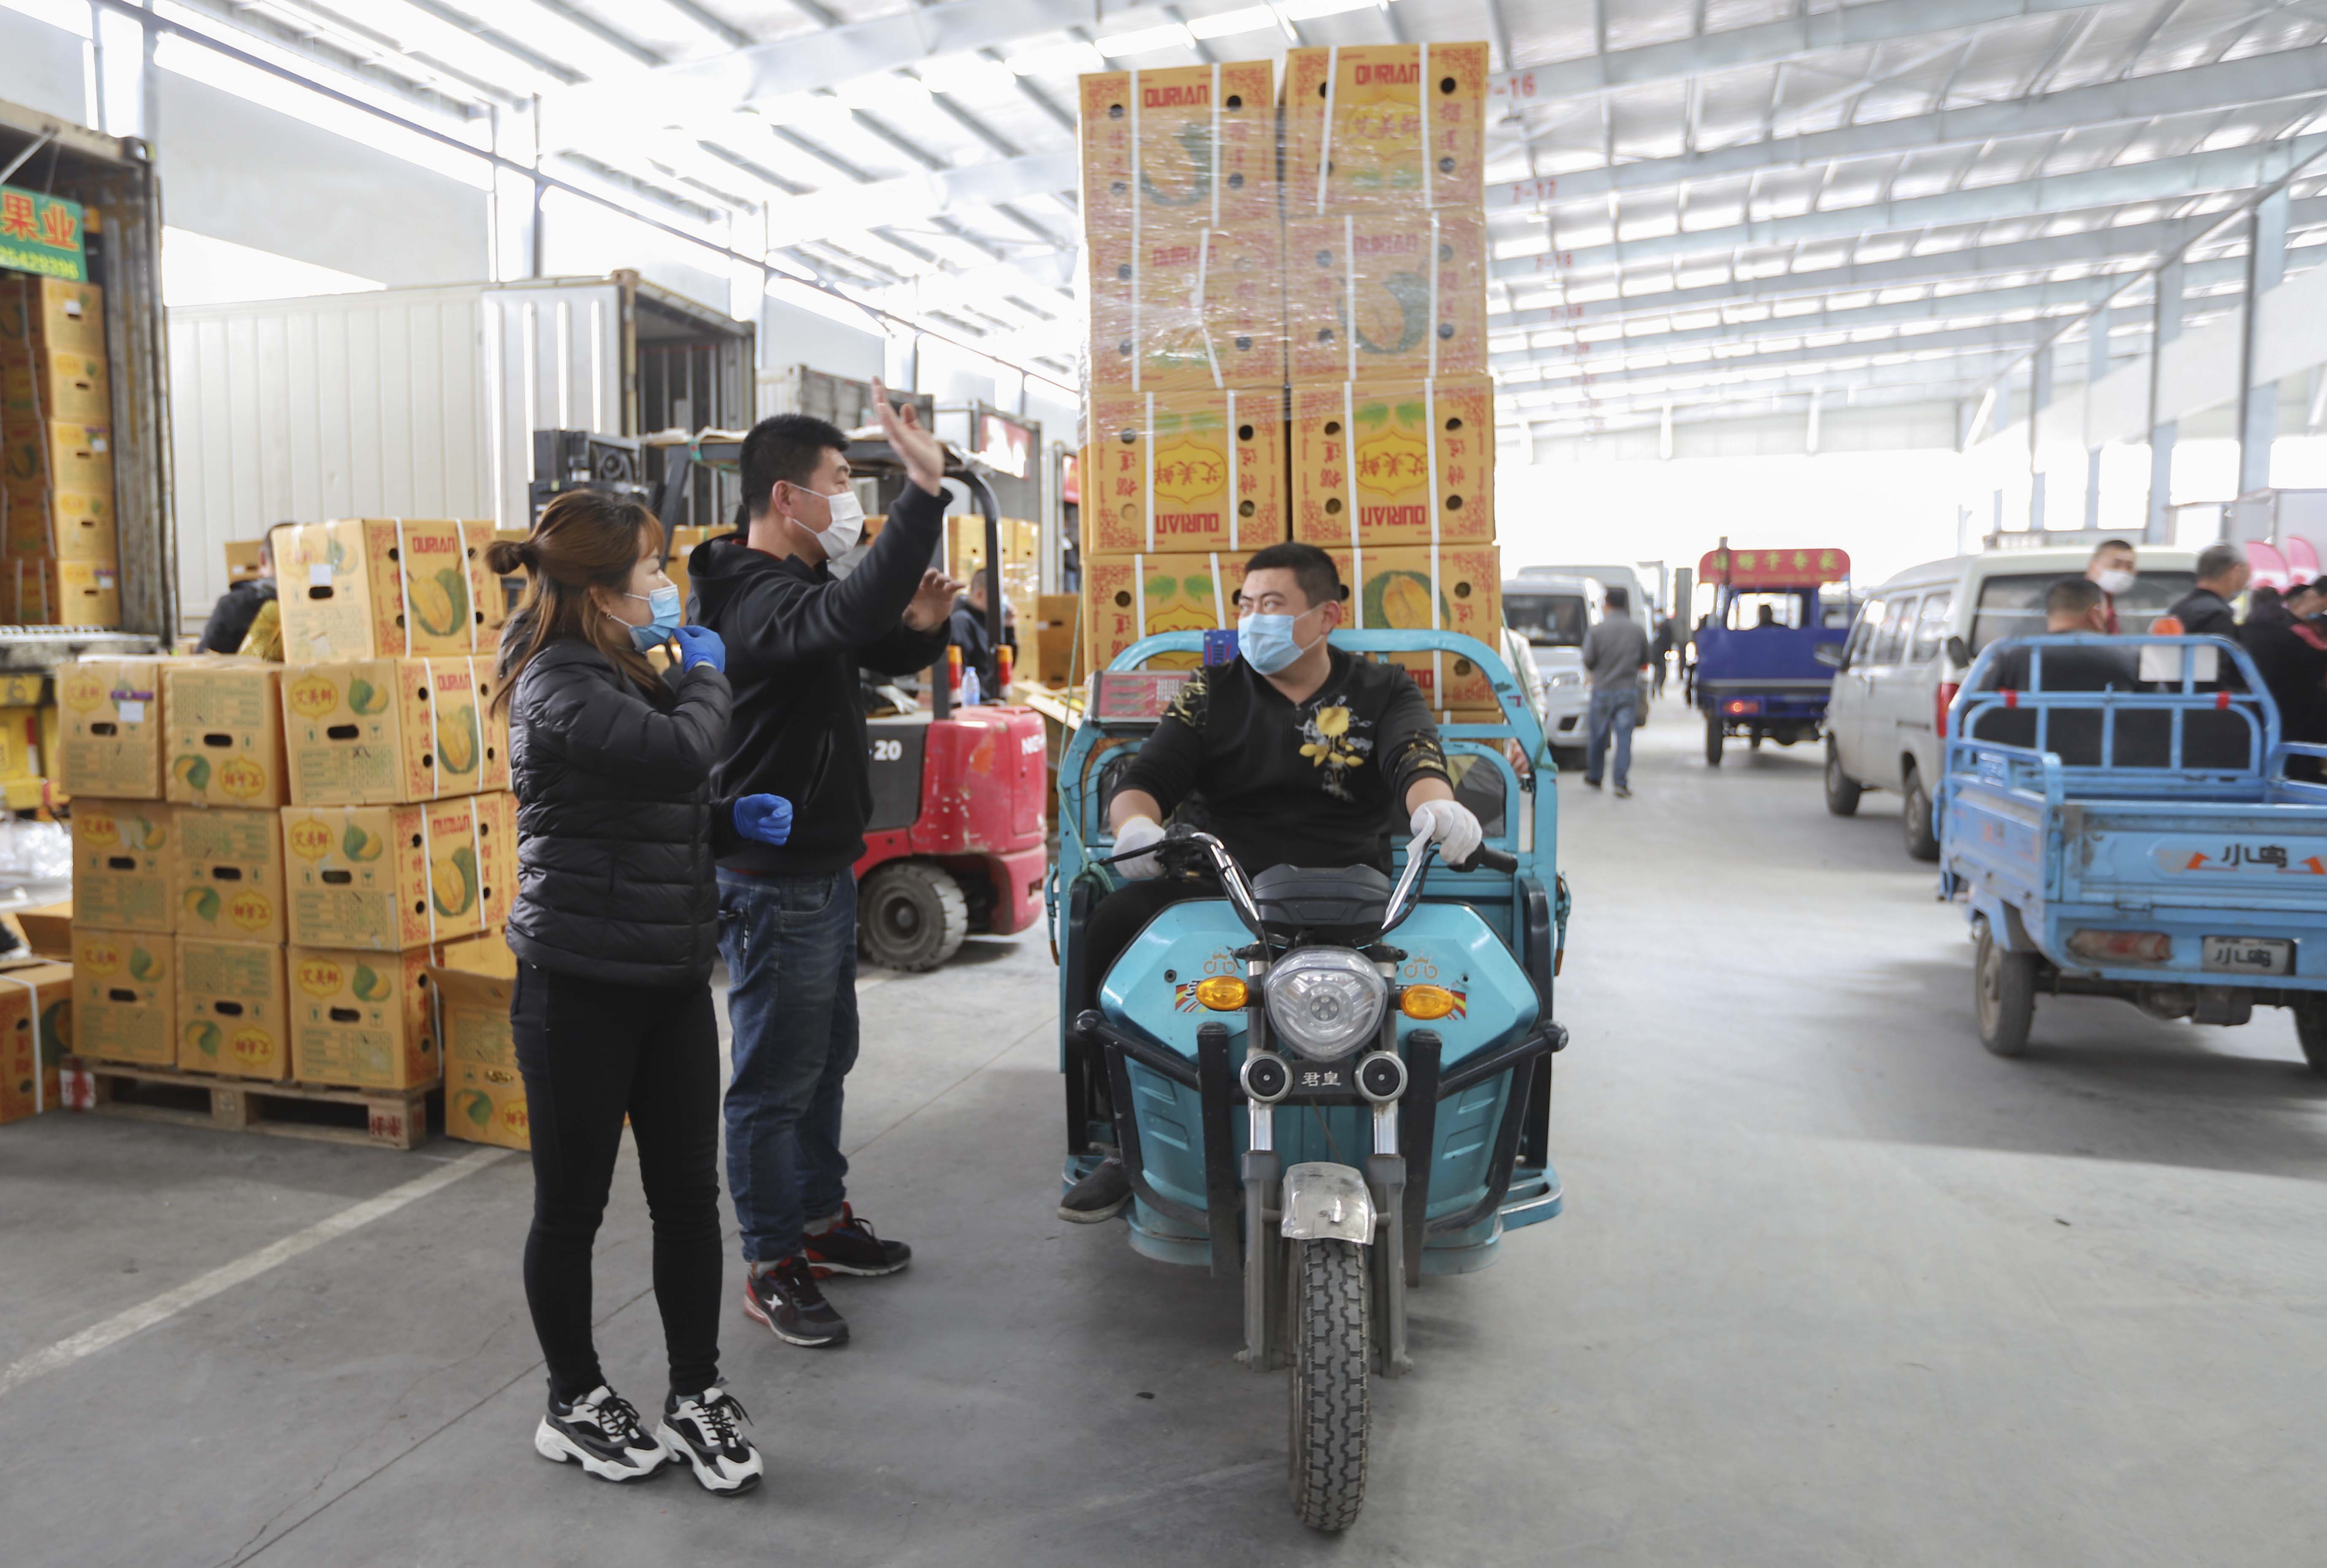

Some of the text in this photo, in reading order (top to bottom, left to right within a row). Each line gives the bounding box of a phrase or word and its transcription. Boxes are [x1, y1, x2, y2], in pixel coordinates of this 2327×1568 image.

[1355, 64, 1420, 85] DURIAN
[1145, 85, 1208, 108] DURIAN
[1, 192, 80, 251] 果业
[1156, 513, 1219, 533] DURIAN
[1361, 505, 1426, 527] DURIAN
[412, 537, 456, 554] DURIAN
[874, 740, 902, 760] 20
[2221, 843, 2288, 869] 小鸟
[2214, 947, 2272, 968] 小鸟
[1301, 1070, 1342, 1087] 君皇
